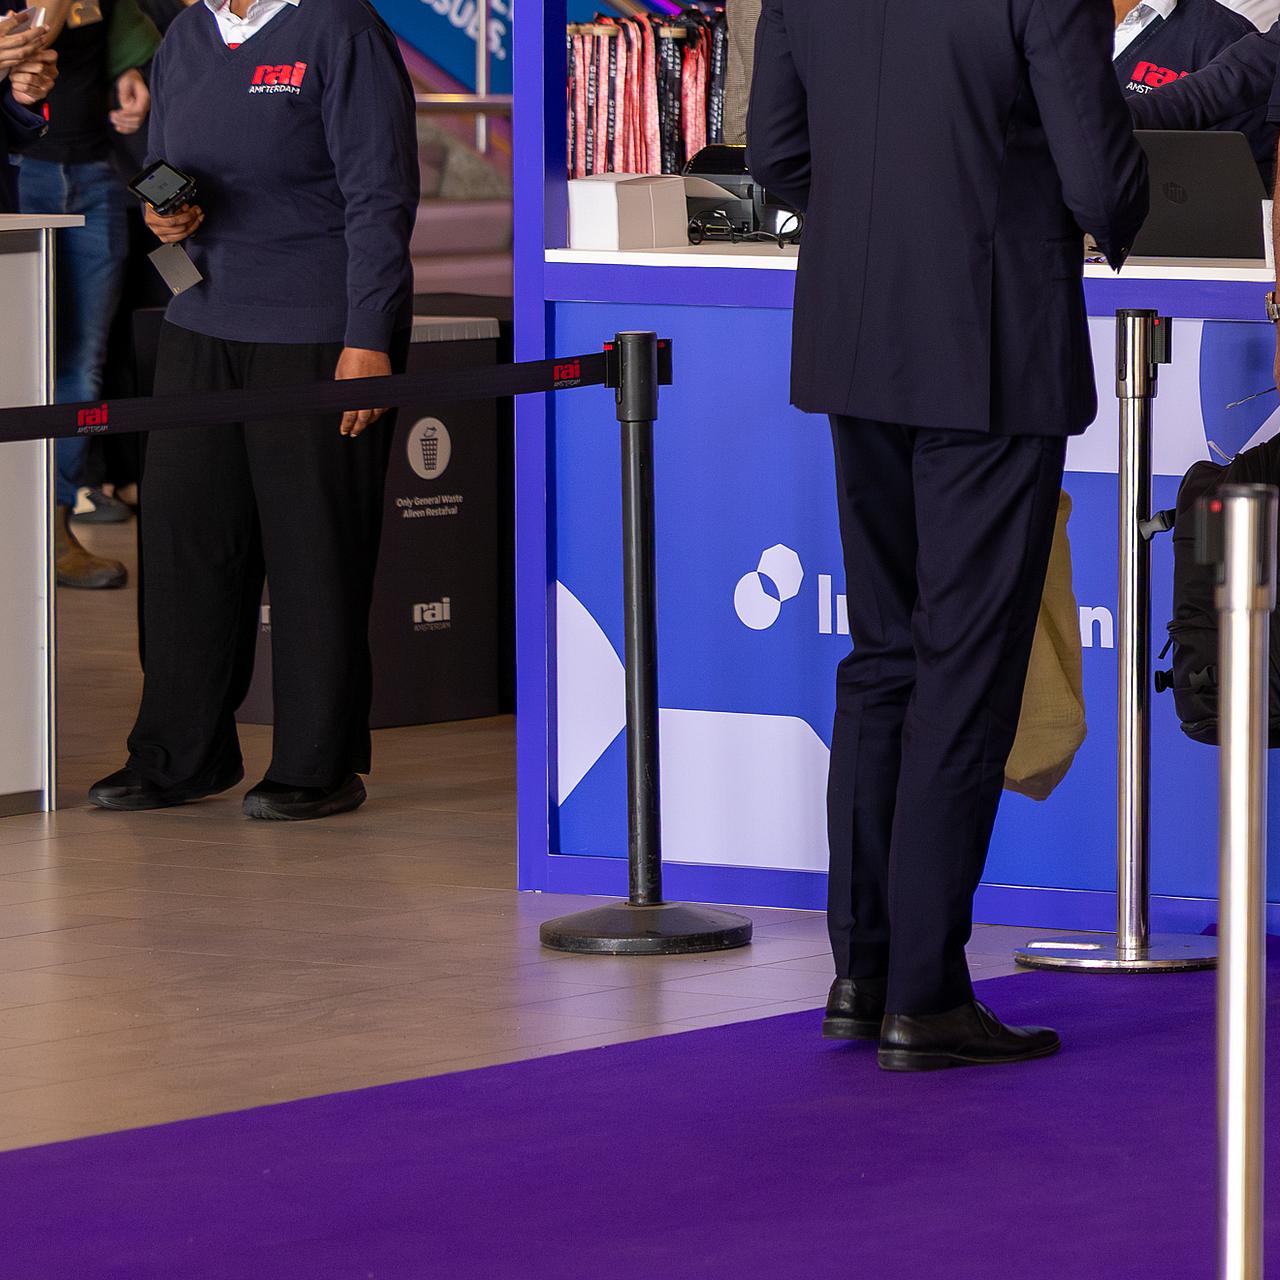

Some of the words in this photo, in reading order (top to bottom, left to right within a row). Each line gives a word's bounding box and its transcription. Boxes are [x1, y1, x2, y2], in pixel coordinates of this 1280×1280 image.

[251, 60, 307, 87] rai
[554, 359, 581, 381] rai
[77, 403, 108, 426] rai
[395, 497, 414, 509] Only
[414, 495, 441, 507] General
[441, 493, 464, 505] Waste
[413, 597, 450, 623] rai
